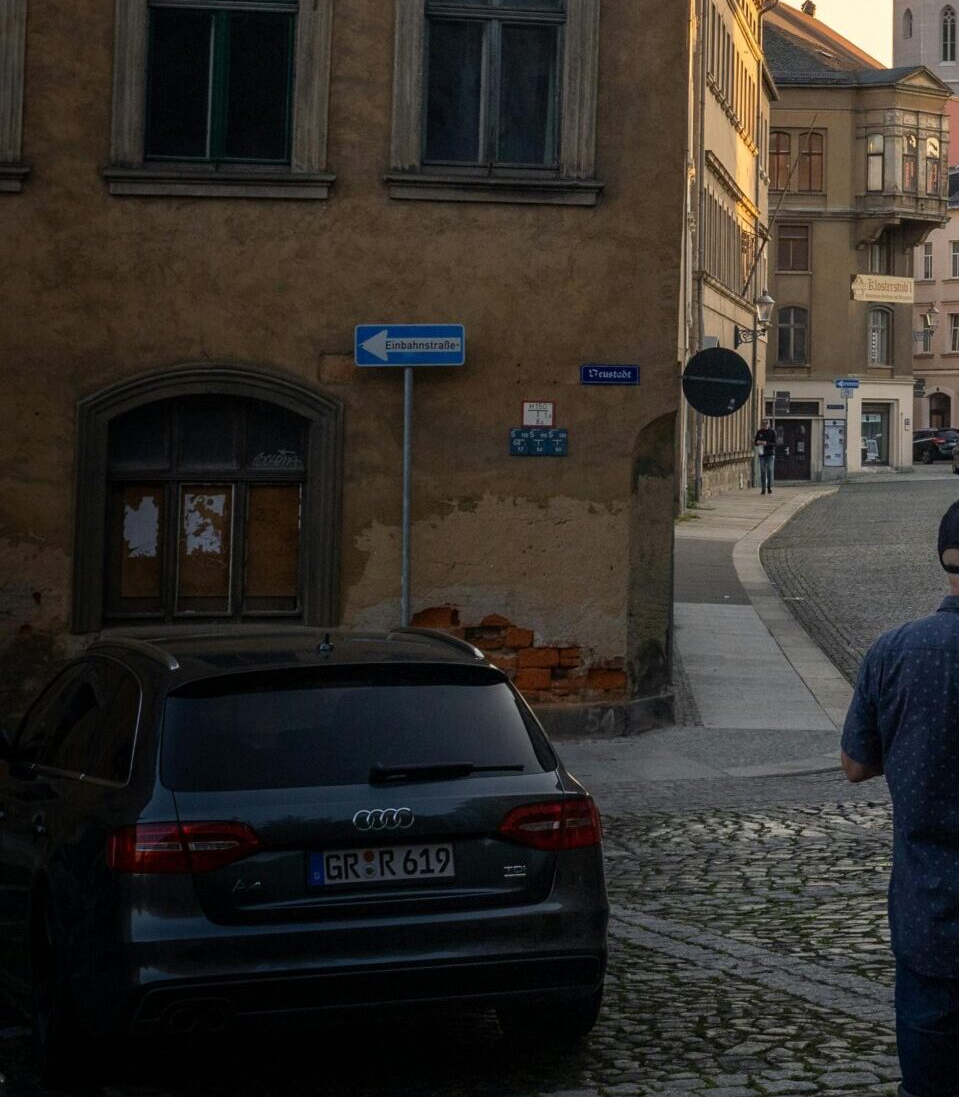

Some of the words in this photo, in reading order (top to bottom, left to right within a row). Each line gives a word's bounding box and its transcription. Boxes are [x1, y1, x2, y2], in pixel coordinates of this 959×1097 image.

[385, 340, 456, 350] Einbahnstraße
[588, 368, 632, 379] Neustadt
[325, 853, 360, 880] GR
[379, 850, 396, 877] R
[402, 847, 450, 875] 619
